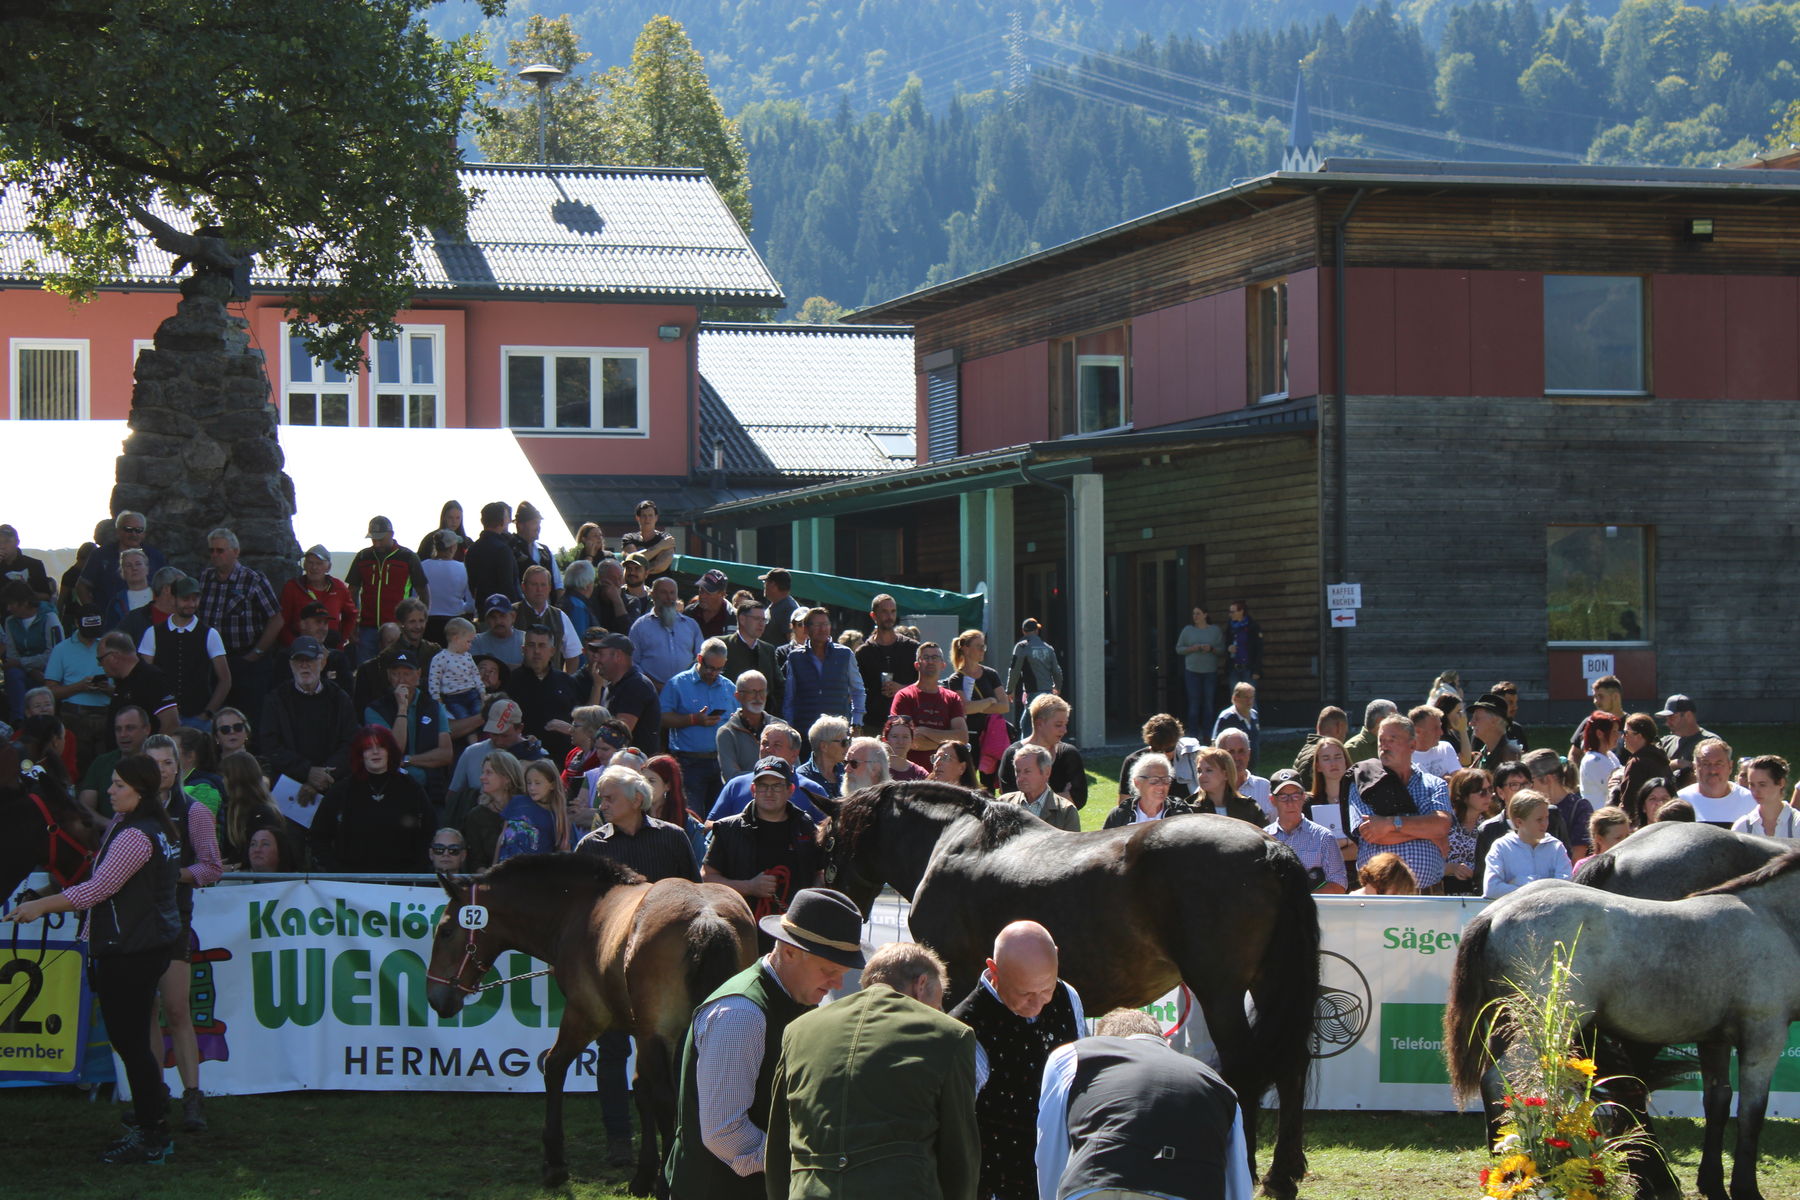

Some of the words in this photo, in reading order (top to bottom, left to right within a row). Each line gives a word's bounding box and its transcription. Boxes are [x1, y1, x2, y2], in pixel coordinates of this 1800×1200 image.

[1588, 659, 1608, 672] BON
[466, 909, 482, 926] 52
[0, 1043, 64, 1060] ember
